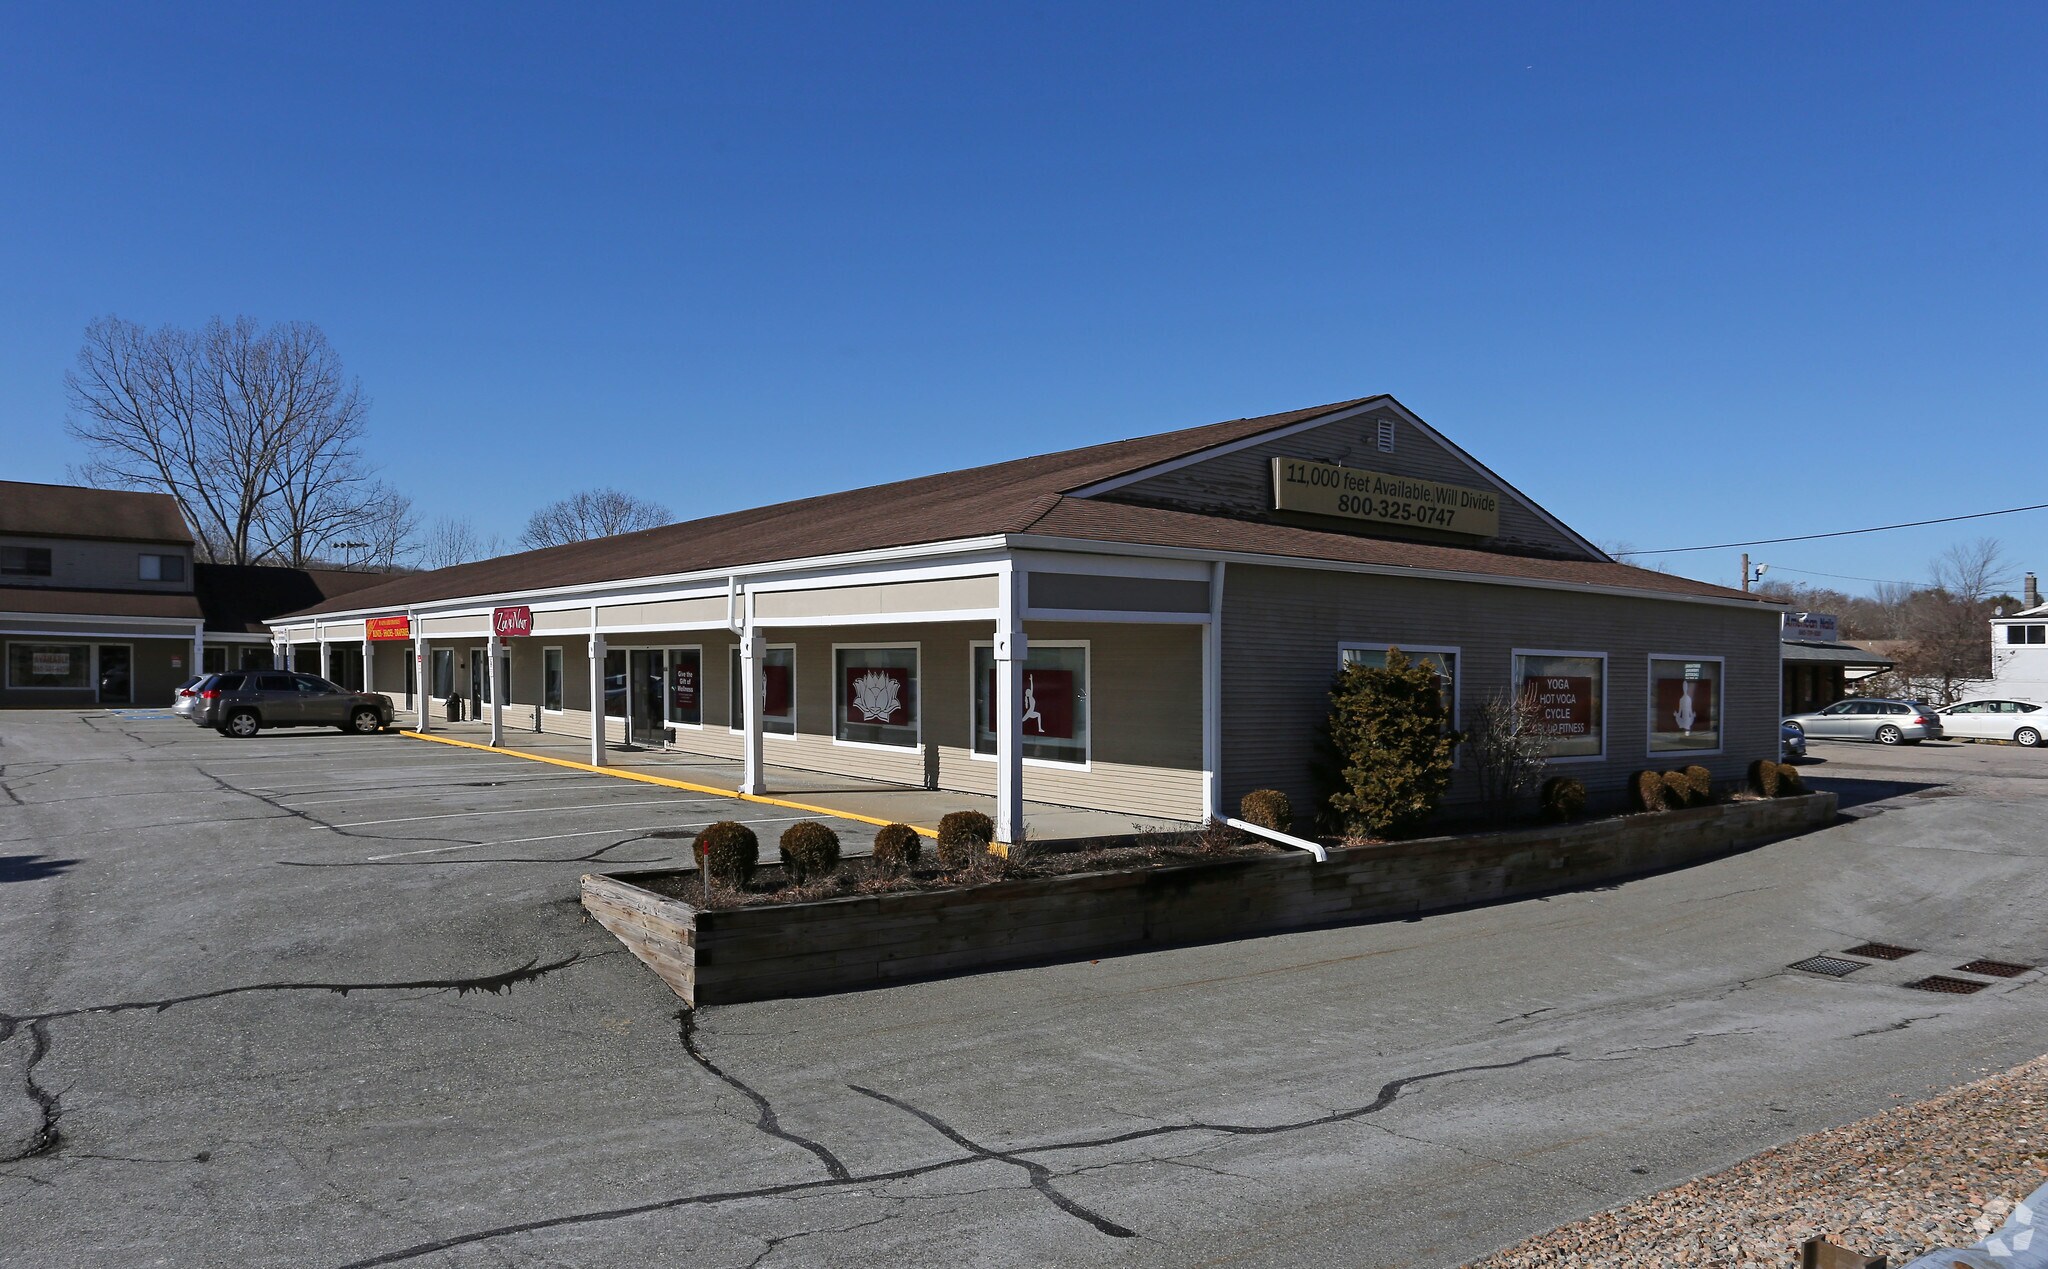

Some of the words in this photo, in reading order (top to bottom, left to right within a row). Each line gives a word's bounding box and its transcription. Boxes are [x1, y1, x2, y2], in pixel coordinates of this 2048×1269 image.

[1286, 463, 1340, 488] 11,000
[1343, 472, 1371, 493] feet
[1435, 486, 1458, 506] Will
[1461, 490, 1495, 512] Divide
[1338, 494, 1455, 526] 800-325-0747
[677, 670, 686, 678] Give
[677, 685, 694, 693] Wellness
[1547, 679, 1569, 689] YOGA
[1540, 693, 1555, 704] HOT
[1556, 693, 1576, 704] YOGA
[1545, 708, 1570, 719] CYCLE
[1559, 722, 1585, 733] FITNESS
